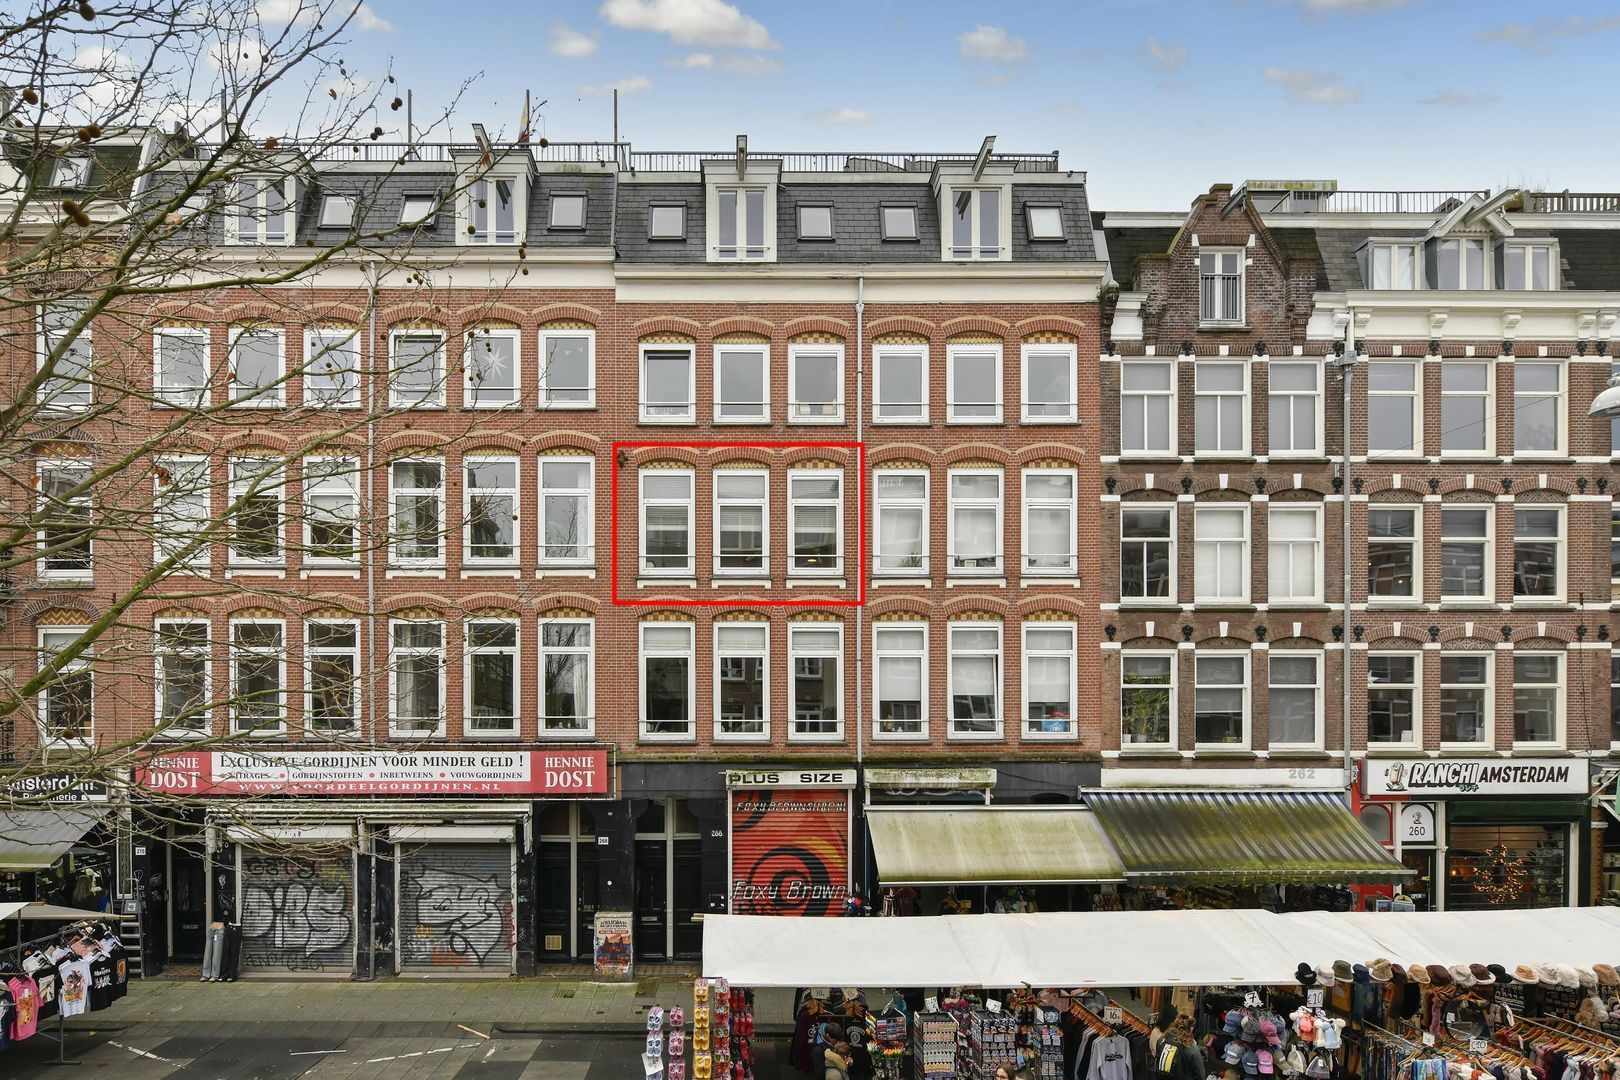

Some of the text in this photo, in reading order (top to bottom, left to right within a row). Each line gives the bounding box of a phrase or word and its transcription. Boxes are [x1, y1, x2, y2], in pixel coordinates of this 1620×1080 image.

[303, 757, 377, 768] GORDIJNEN
[382, 757, 418, 767] VOOR
[423, 757, 476, 767] MINDER
[481, 757, 513, 767] GELD
[545, 757, 595, 768] HENNIE
[149, 771, 201, 788] DOST
[545, 771, 595, 788] DOST
[728, 773, 843, 784] PLUS SIZE
[1288, 769, 1315, 779] 262
[1408, 763, 1569, 787] RANCHI AMSTERDAM
[1409, 827, 1425, 836] 260
[787, 881, 846, 899] Brown
